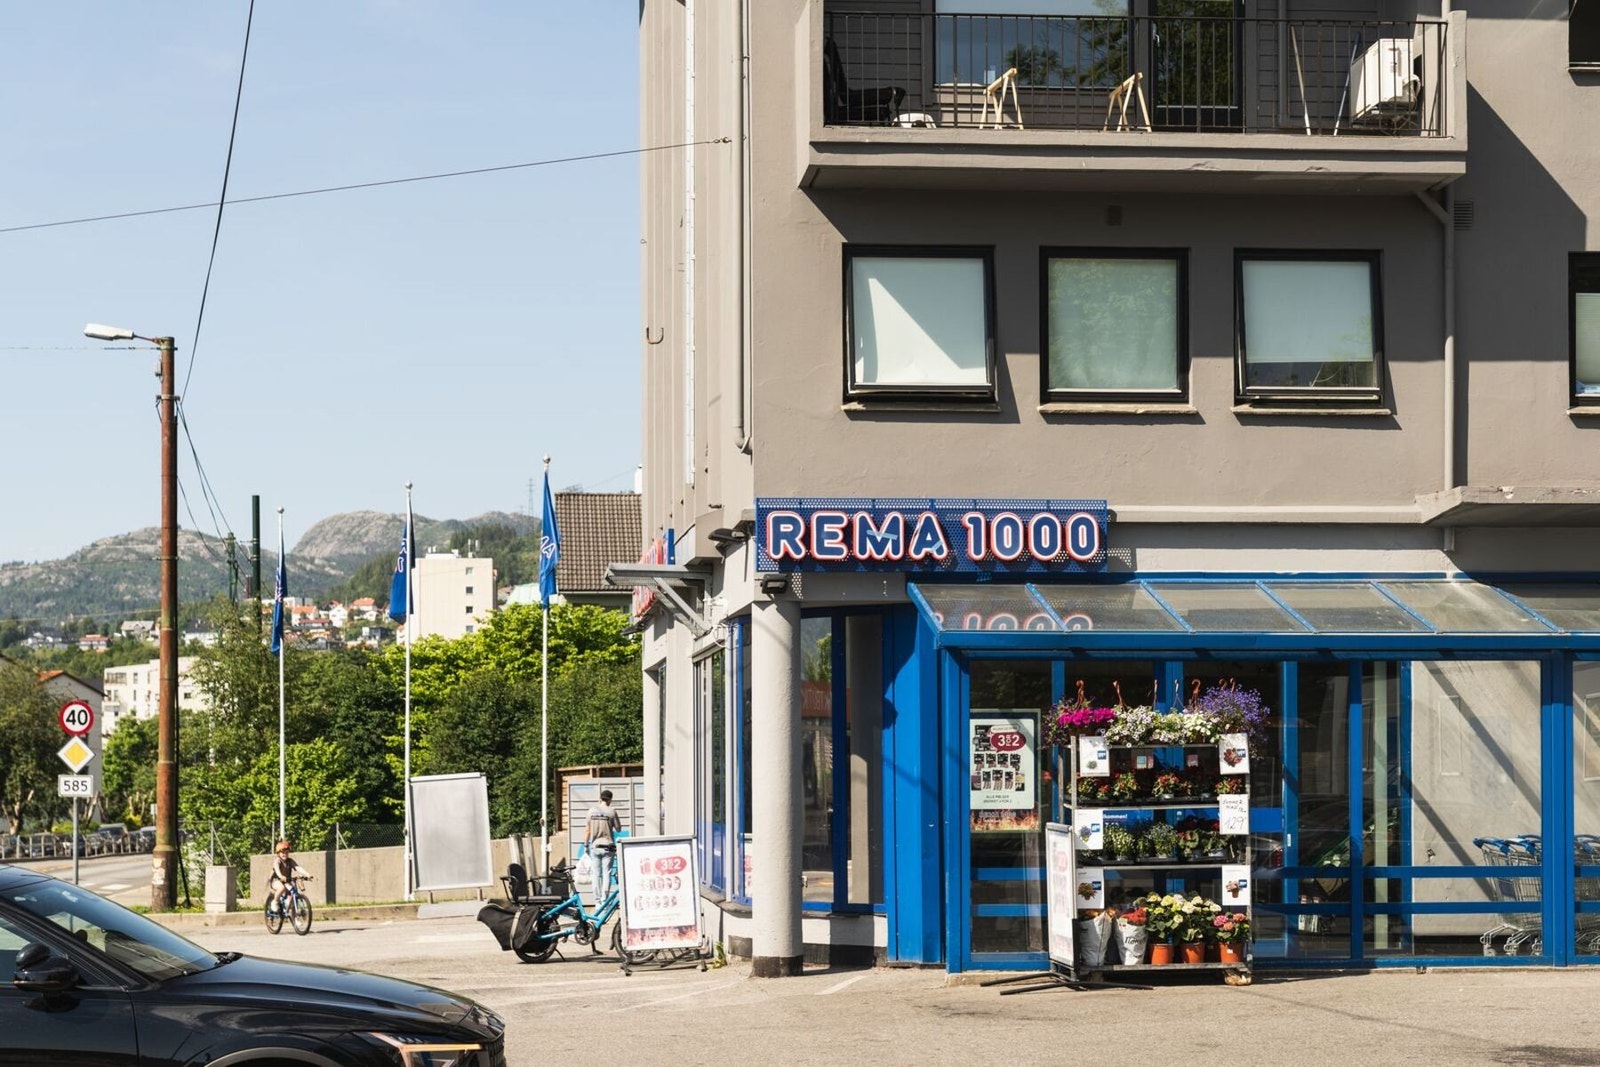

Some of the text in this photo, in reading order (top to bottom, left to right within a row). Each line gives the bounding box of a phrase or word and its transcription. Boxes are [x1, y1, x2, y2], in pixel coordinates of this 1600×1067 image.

[766, 510, 1099, 561] REMA 1000
[66, 709, 88, 725] 40
[998, 735, 1005, 746] 3
[1012, 735, 1019, 746] 2
[64, 780, 87, 791] 585
